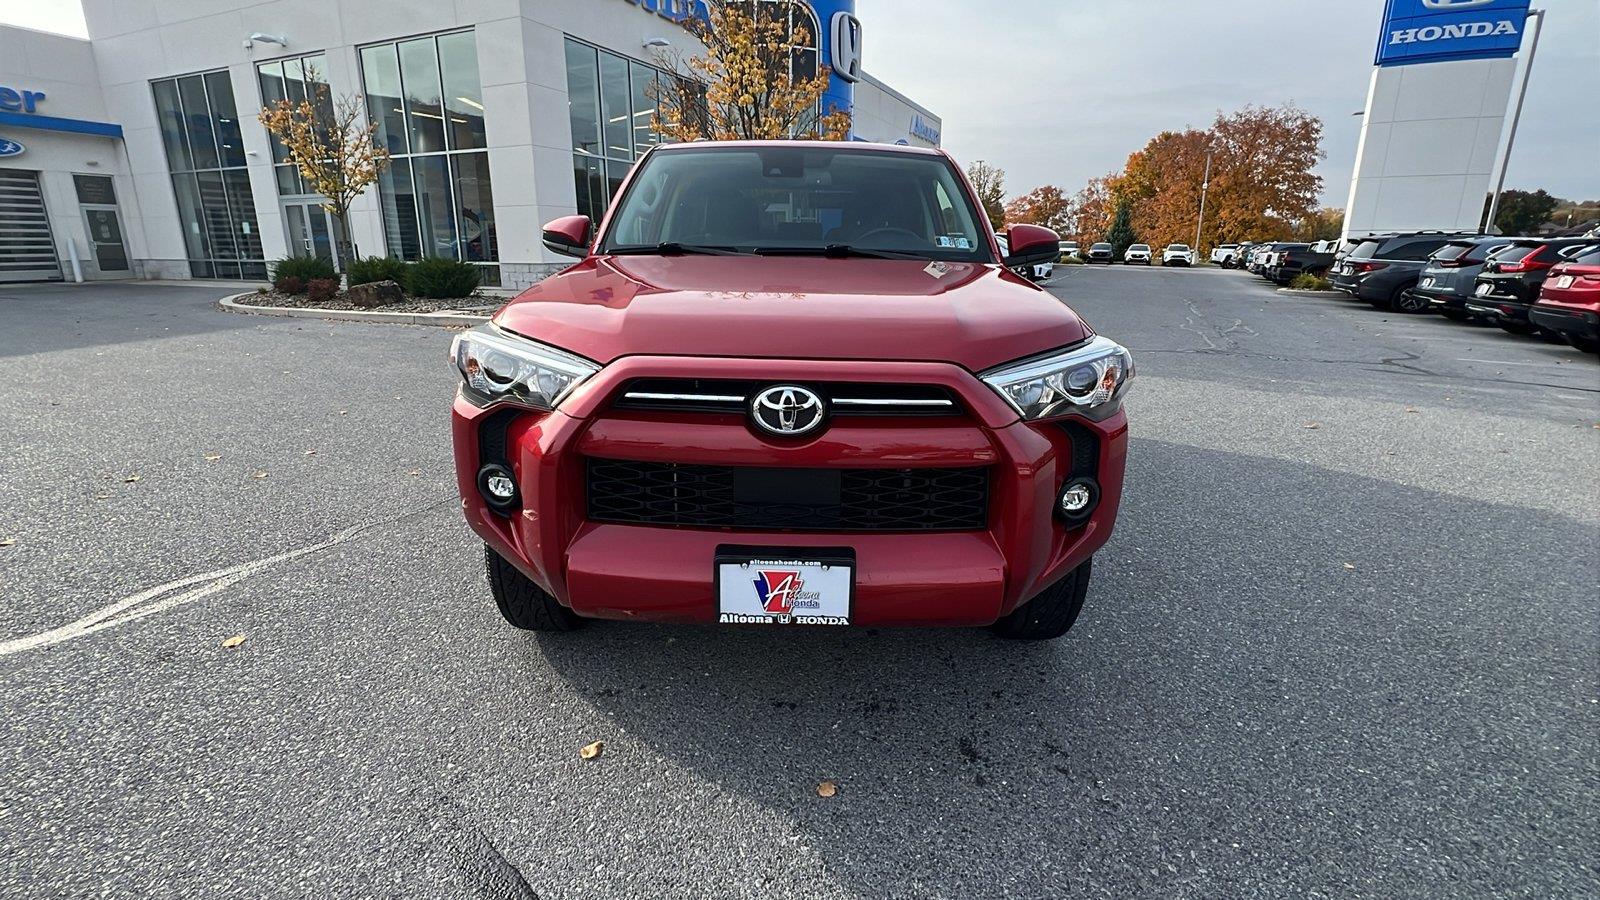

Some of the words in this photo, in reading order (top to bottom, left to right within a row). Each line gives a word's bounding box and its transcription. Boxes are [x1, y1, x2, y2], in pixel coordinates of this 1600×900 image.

[1389, 20, 1518, 45] HONDA
[764, 575, 820, 608] Altoona
[786, 598, 818, 608] Honda
[719, 613, 773, 624] Altoona
[796, 616, 850, 625] HONDA
